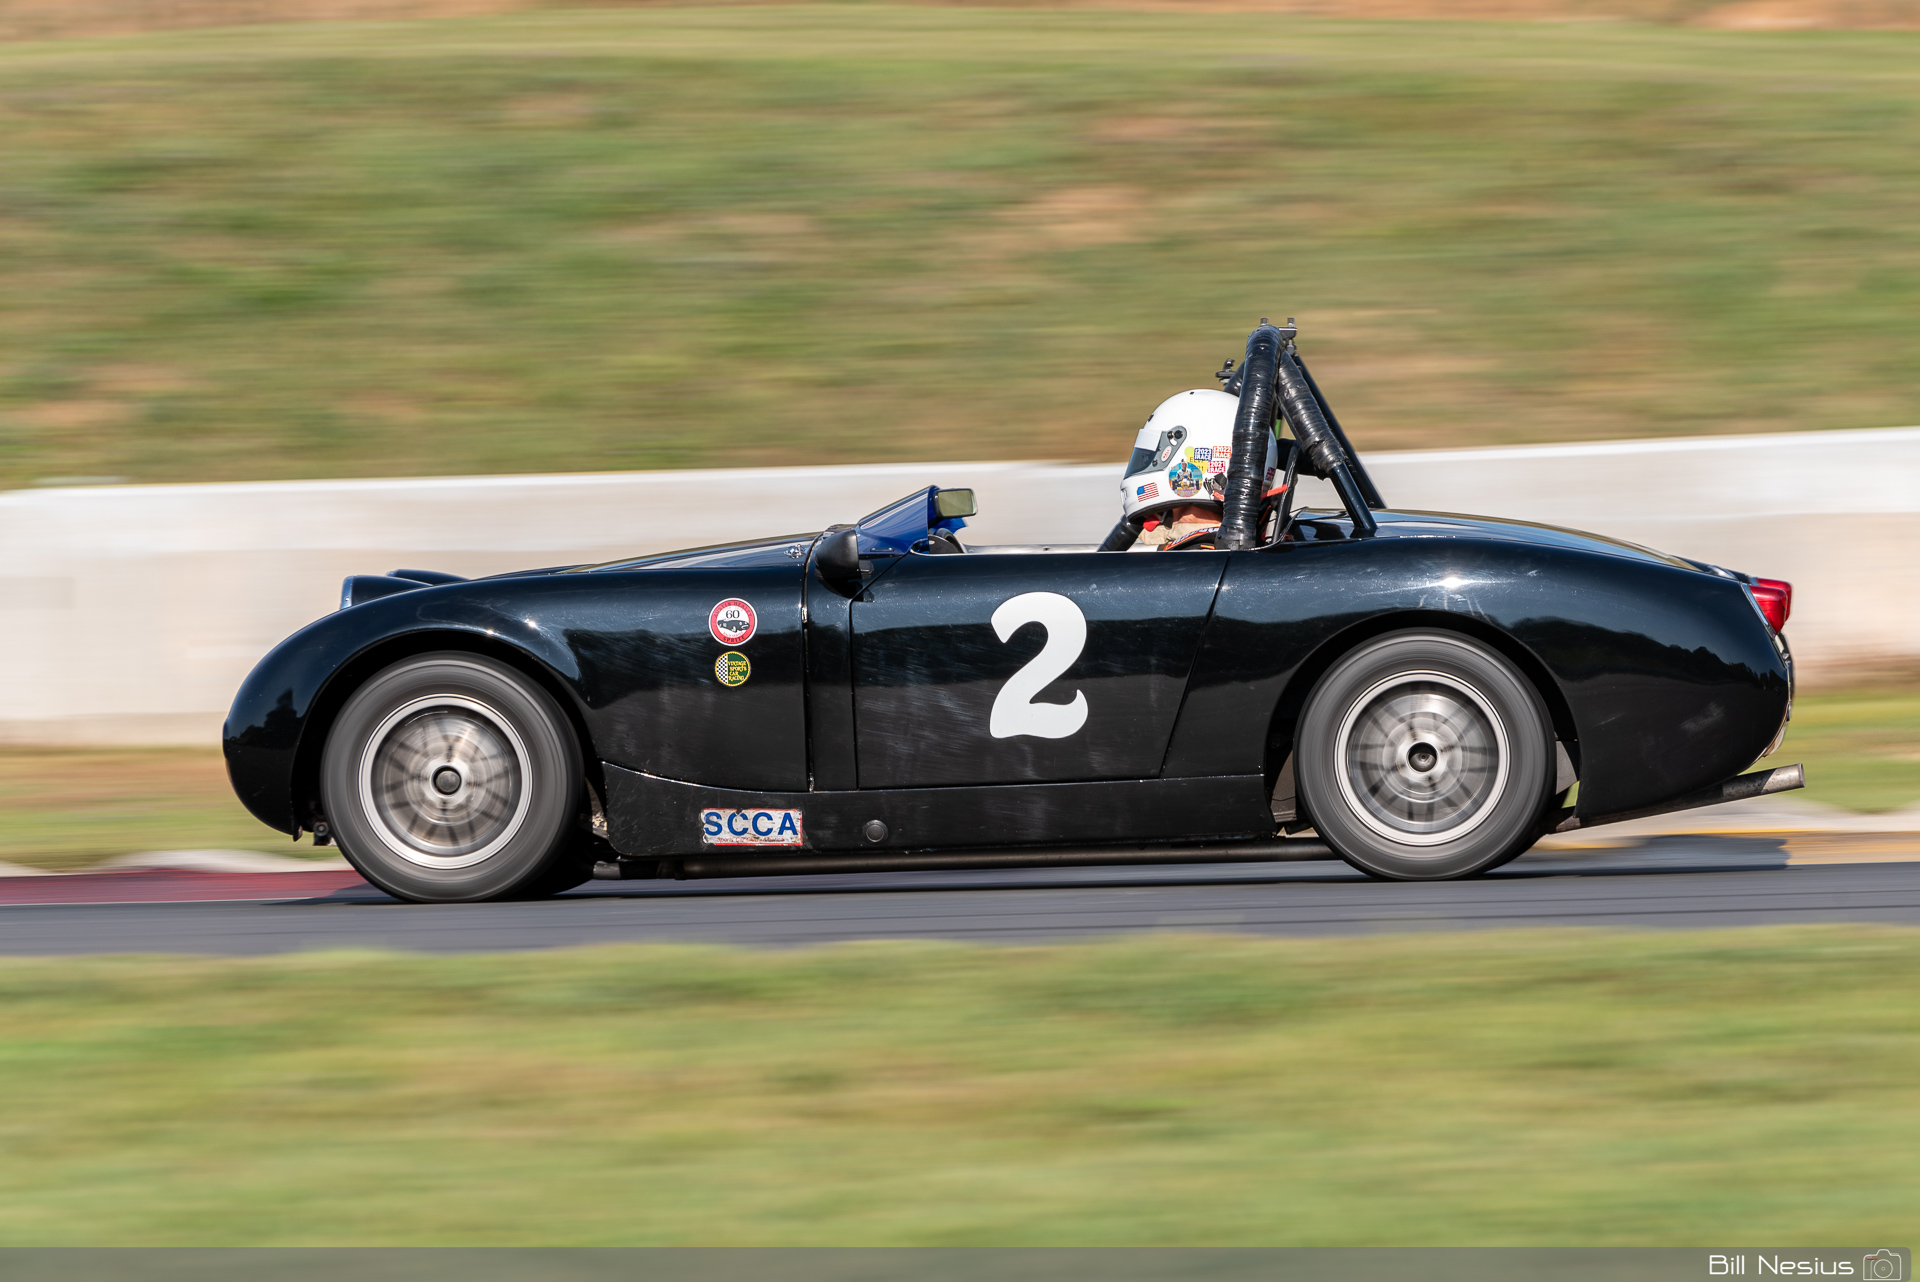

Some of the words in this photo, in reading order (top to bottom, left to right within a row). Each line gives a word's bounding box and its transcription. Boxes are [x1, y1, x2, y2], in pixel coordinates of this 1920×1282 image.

[726, 610, 740, 619] 60
[723, 635, 745, 643] SPRITE
[989, 591, 1089, 739] 2
[704, 812, 798, 836] SCCA
